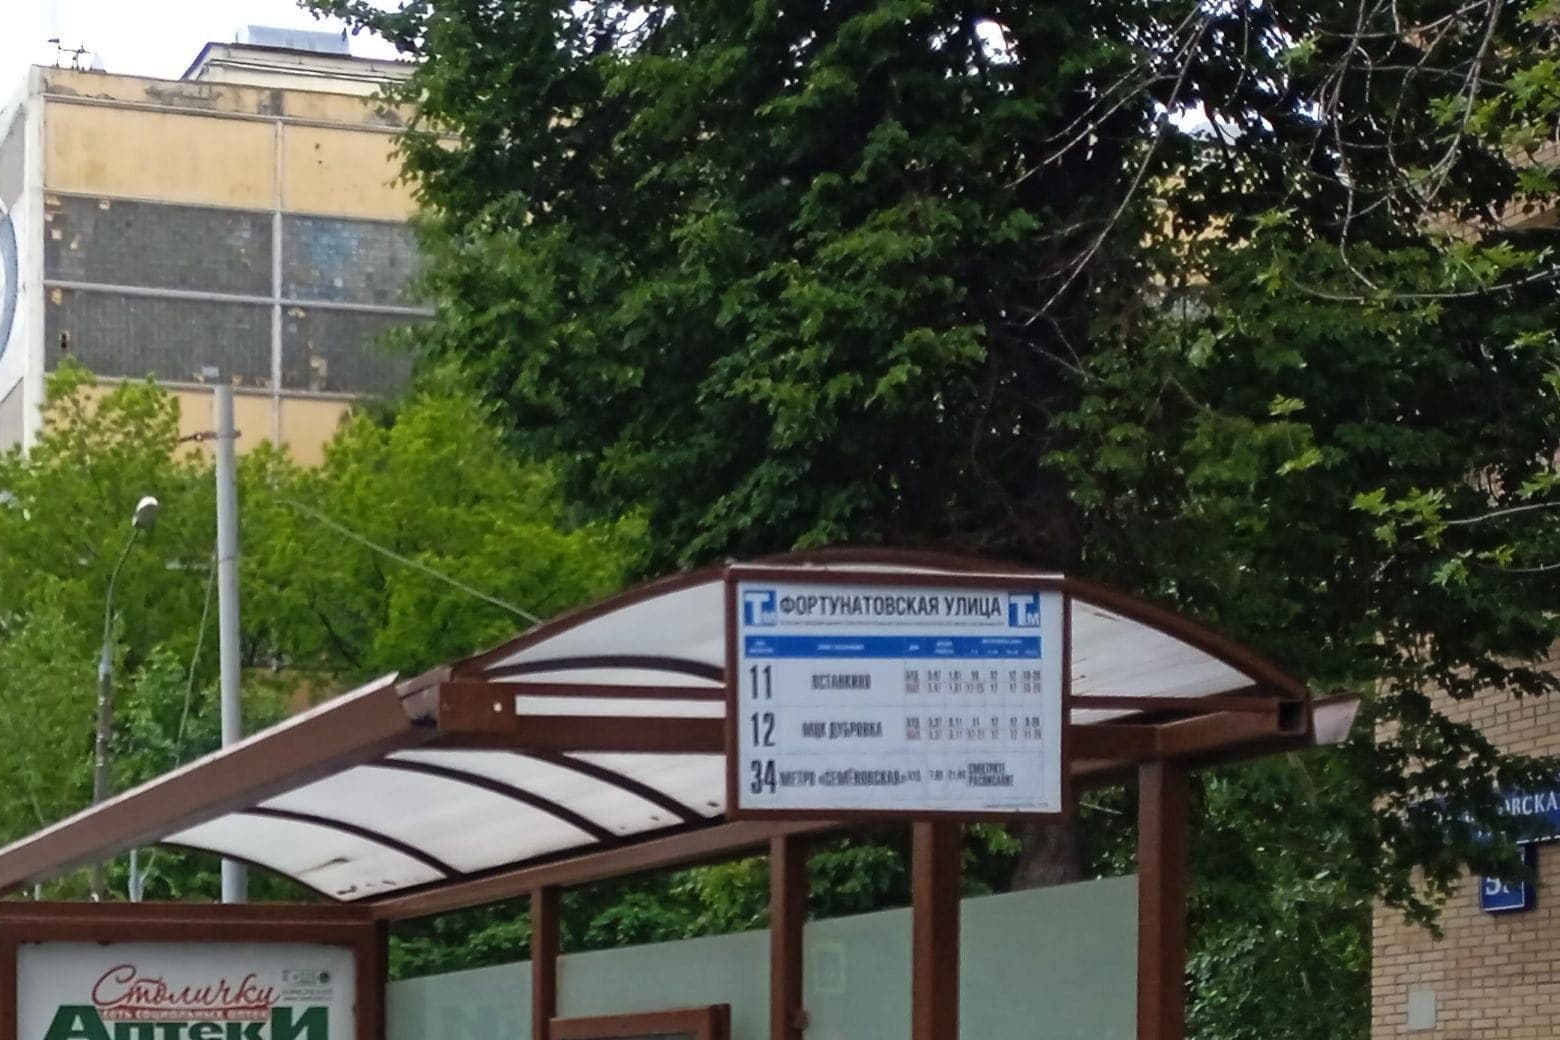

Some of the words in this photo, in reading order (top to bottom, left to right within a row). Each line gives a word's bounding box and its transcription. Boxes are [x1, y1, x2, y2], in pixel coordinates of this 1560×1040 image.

[779, 594, 939, 617] ФОРТУНАТОВСКАЯ
[945, 596, 1002, 619] УЛИЦА
[750, 664, 772, 699] 11
[812, 673, 871, 690] ОСТАНКИНО
[751, 712, 775, 747] 12
[829, 721, 883, 740] ДУБРОВКА
[751, 760, 776, 794] 34
[780, 771, 816, 786] МЕТРО
[91, 964, 279, 1006] Столички
